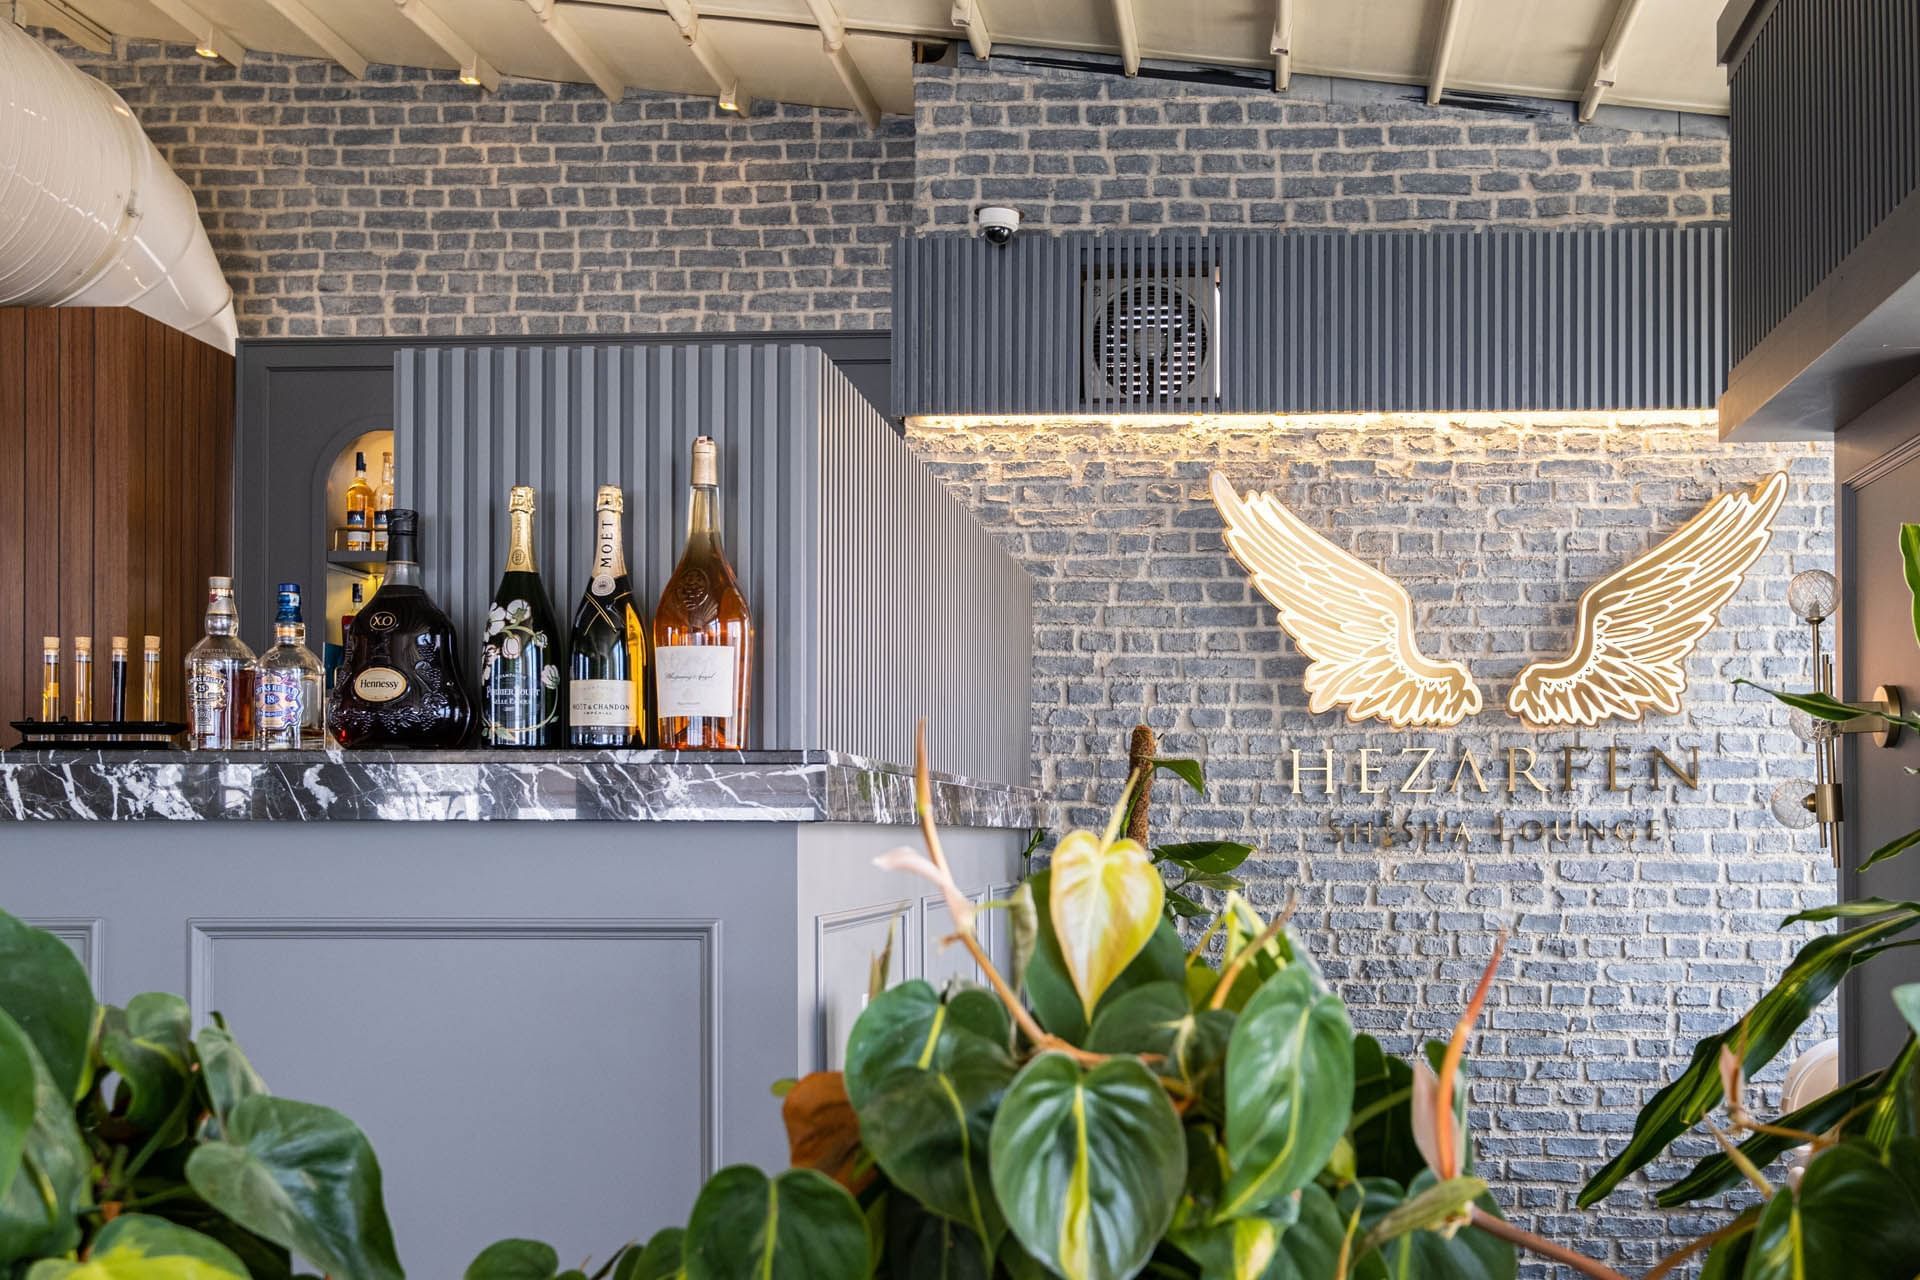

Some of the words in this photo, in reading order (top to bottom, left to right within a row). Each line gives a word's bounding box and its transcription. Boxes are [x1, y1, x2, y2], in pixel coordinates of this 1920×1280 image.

[360, 679, 399, 689] Hennessy
[1290, 745, 1699, 795] HEZARFEN
[1497, 815, 1661, 843] LOUNGE
